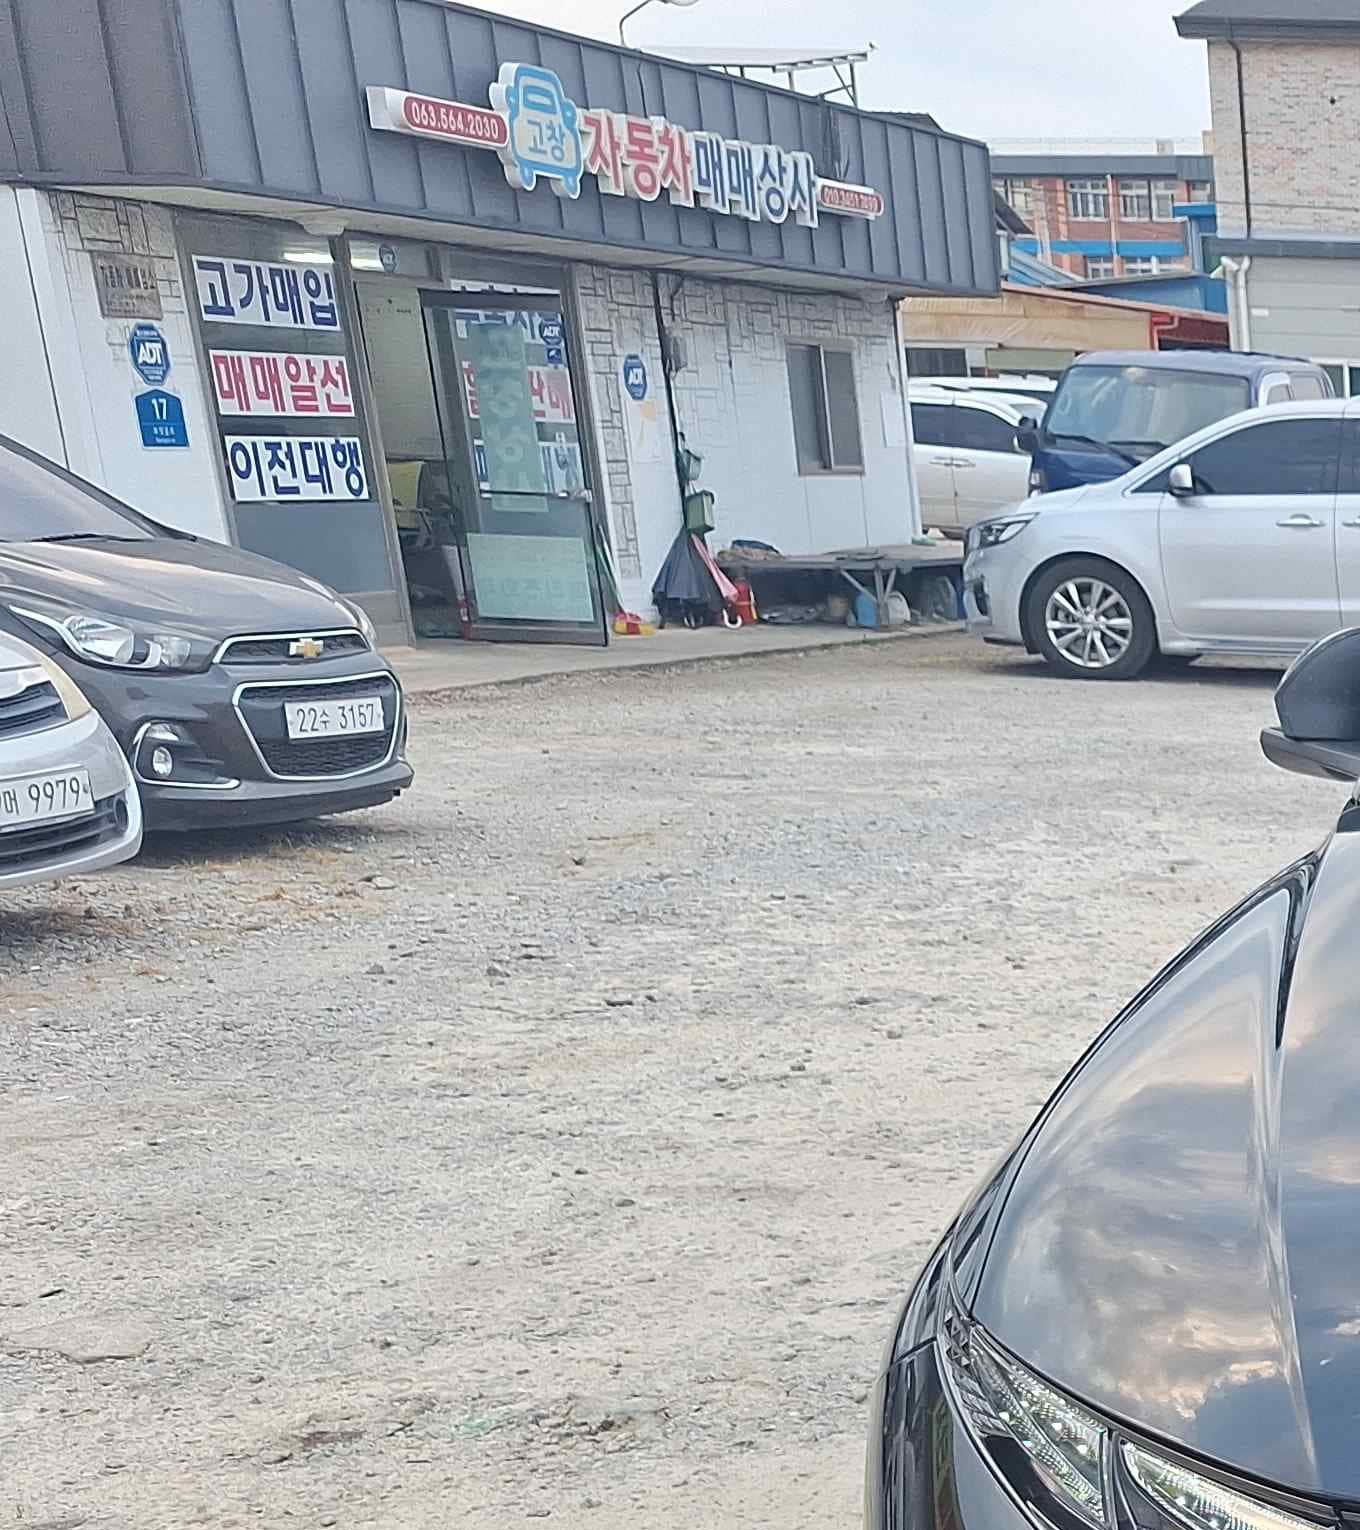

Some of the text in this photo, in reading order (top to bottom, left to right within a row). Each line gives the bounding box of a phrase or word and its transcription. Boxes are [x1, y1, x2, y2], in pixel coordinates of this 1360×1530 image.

[526, 119, 566, 161] 고창
[197, 260, 338, 326] 고가매입
[138, 342, 162, 365] ADT
[212, 354, 352, 412] 매매알선
[628, 367, 644, 385] ADT
[151, 398, 167, 420] 17
[230, 438, 364, 496] 이전대행
[297, 704, 374, 732] 22수 3157
[0, 776, 80, 816] 머 9979
